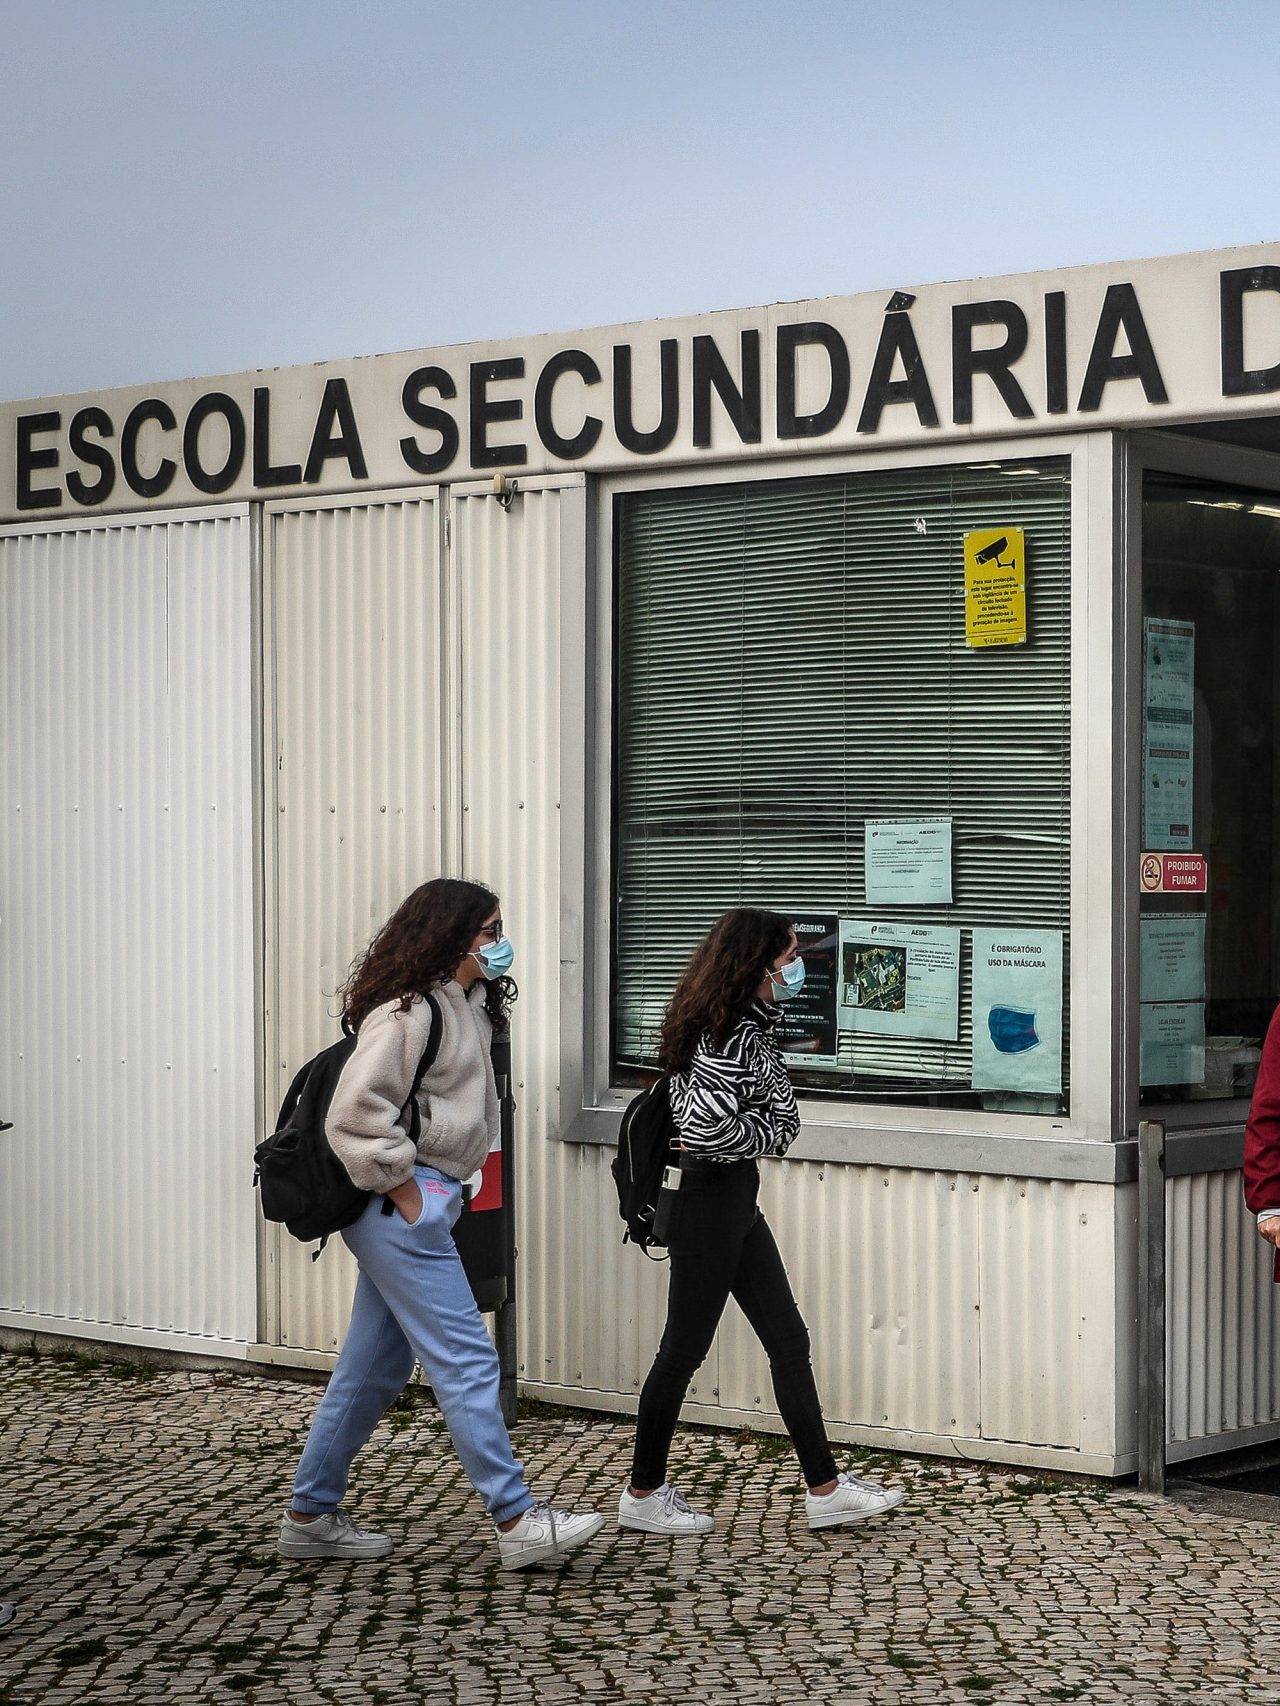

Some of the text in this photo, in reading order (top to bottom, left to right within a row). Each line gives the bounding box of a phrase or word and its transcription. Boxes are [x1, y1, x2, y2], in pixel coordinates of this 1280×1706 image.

[17, 378, 368, 509] ESCOLA
[399, 283, 1169, 474] SECUNDÁRIA
[1168, 861, 1201, 871] PROIBIDO
[1172, 876, 1197, 885] FUMAR
[991, 944, 1042, 953] É OBRIGATÓRIO
[1013, 959, 1046, 968] MÁSCARA
